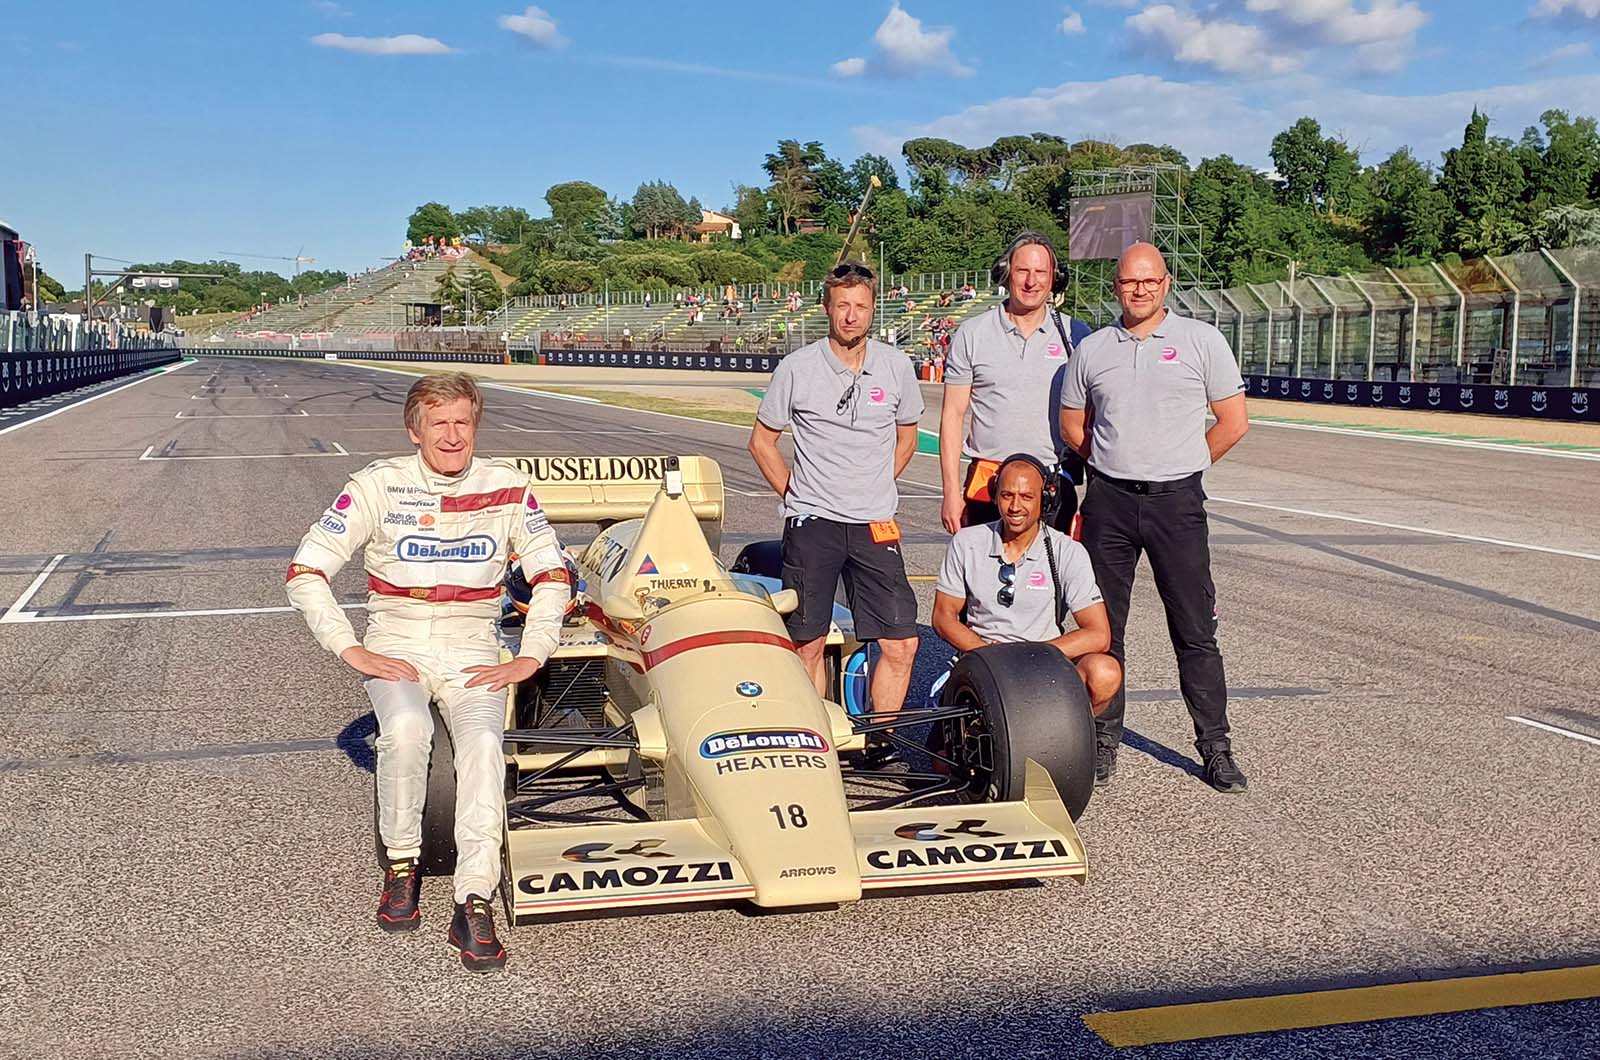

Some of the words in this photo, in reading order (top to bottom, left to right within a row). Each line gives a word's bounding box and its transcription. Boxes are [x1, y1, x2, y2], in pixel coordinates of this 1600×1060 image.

[1494, 390, 1508, 401] aws
[1531, 391, 1547, 403] aws
[1571, 392, 1588, 405] aws
[650, 578, 698, 590] THIERRY
[715, 754, 827, 775] HEATERS
[769, 804, 808, 829] 18
[866, 839, 1068, 870] CAMOZZI
[517, 862, 734, 894] CAMOZZI
[779, 866, 836, 879] ARROWS
